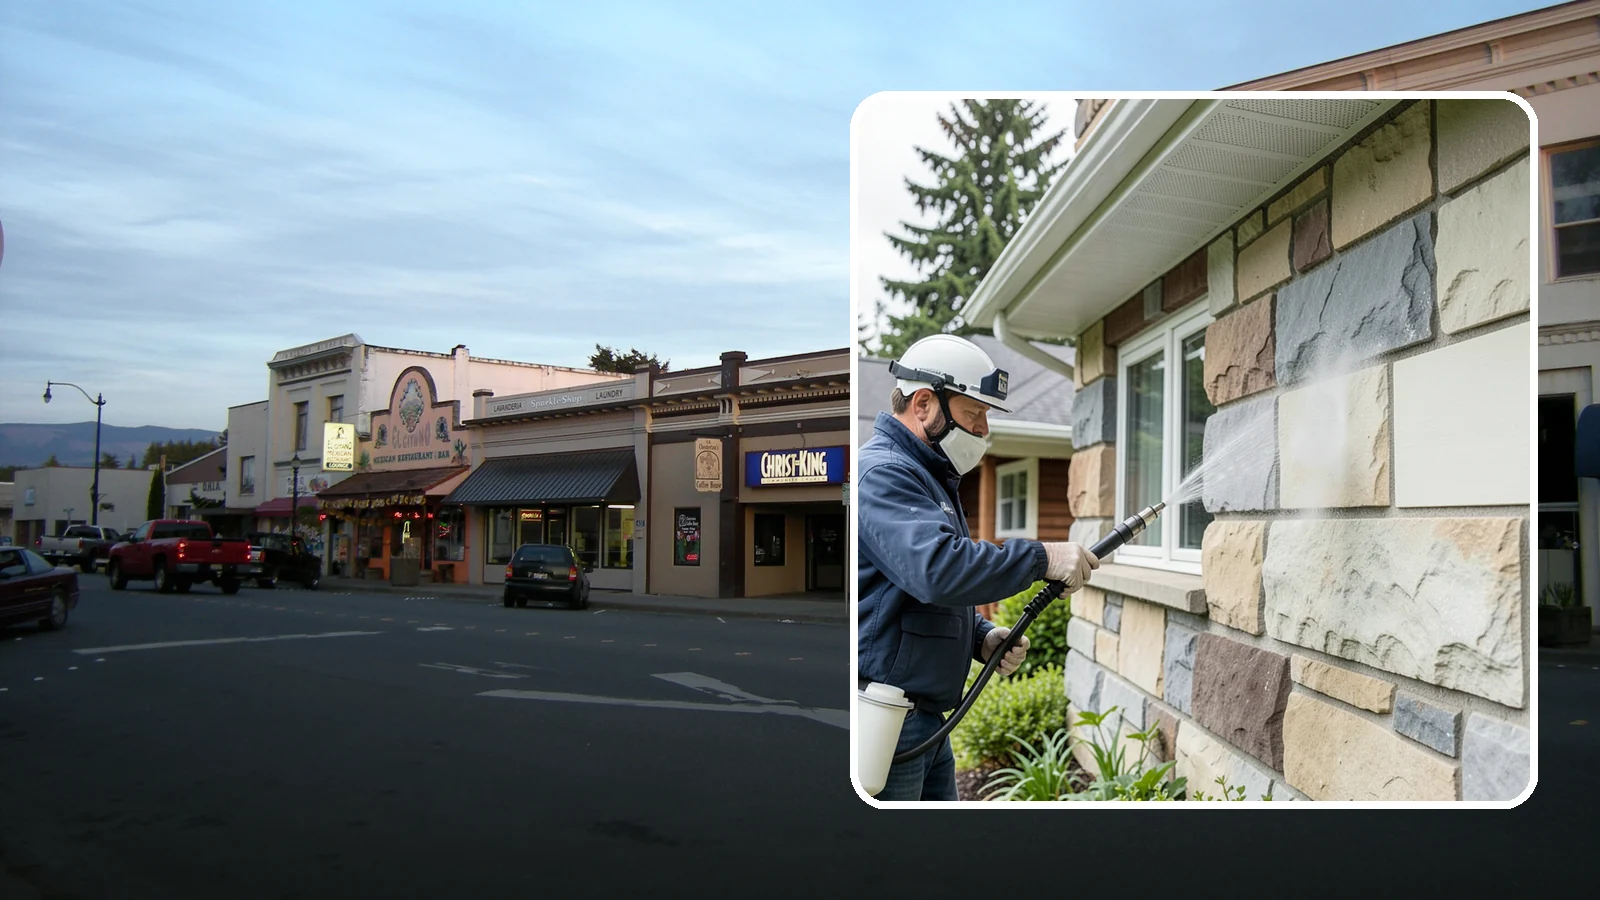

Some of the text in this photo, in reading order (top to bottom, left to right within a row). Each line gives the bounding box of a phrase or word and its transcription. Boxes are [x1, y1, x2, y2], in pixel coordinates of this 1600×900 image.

[493, 402, 522, 412] LAVANDERIA
[562, 394, 583, 406] Shop
[596, 389, 623, 400] LAUNDRY
[373, 454, 396, 464] MEXICAN
[397, 451, 434, 462] RESTAURANT
[438, 450, 450, 459] BAR
[799, 450, 828, 476] KING
